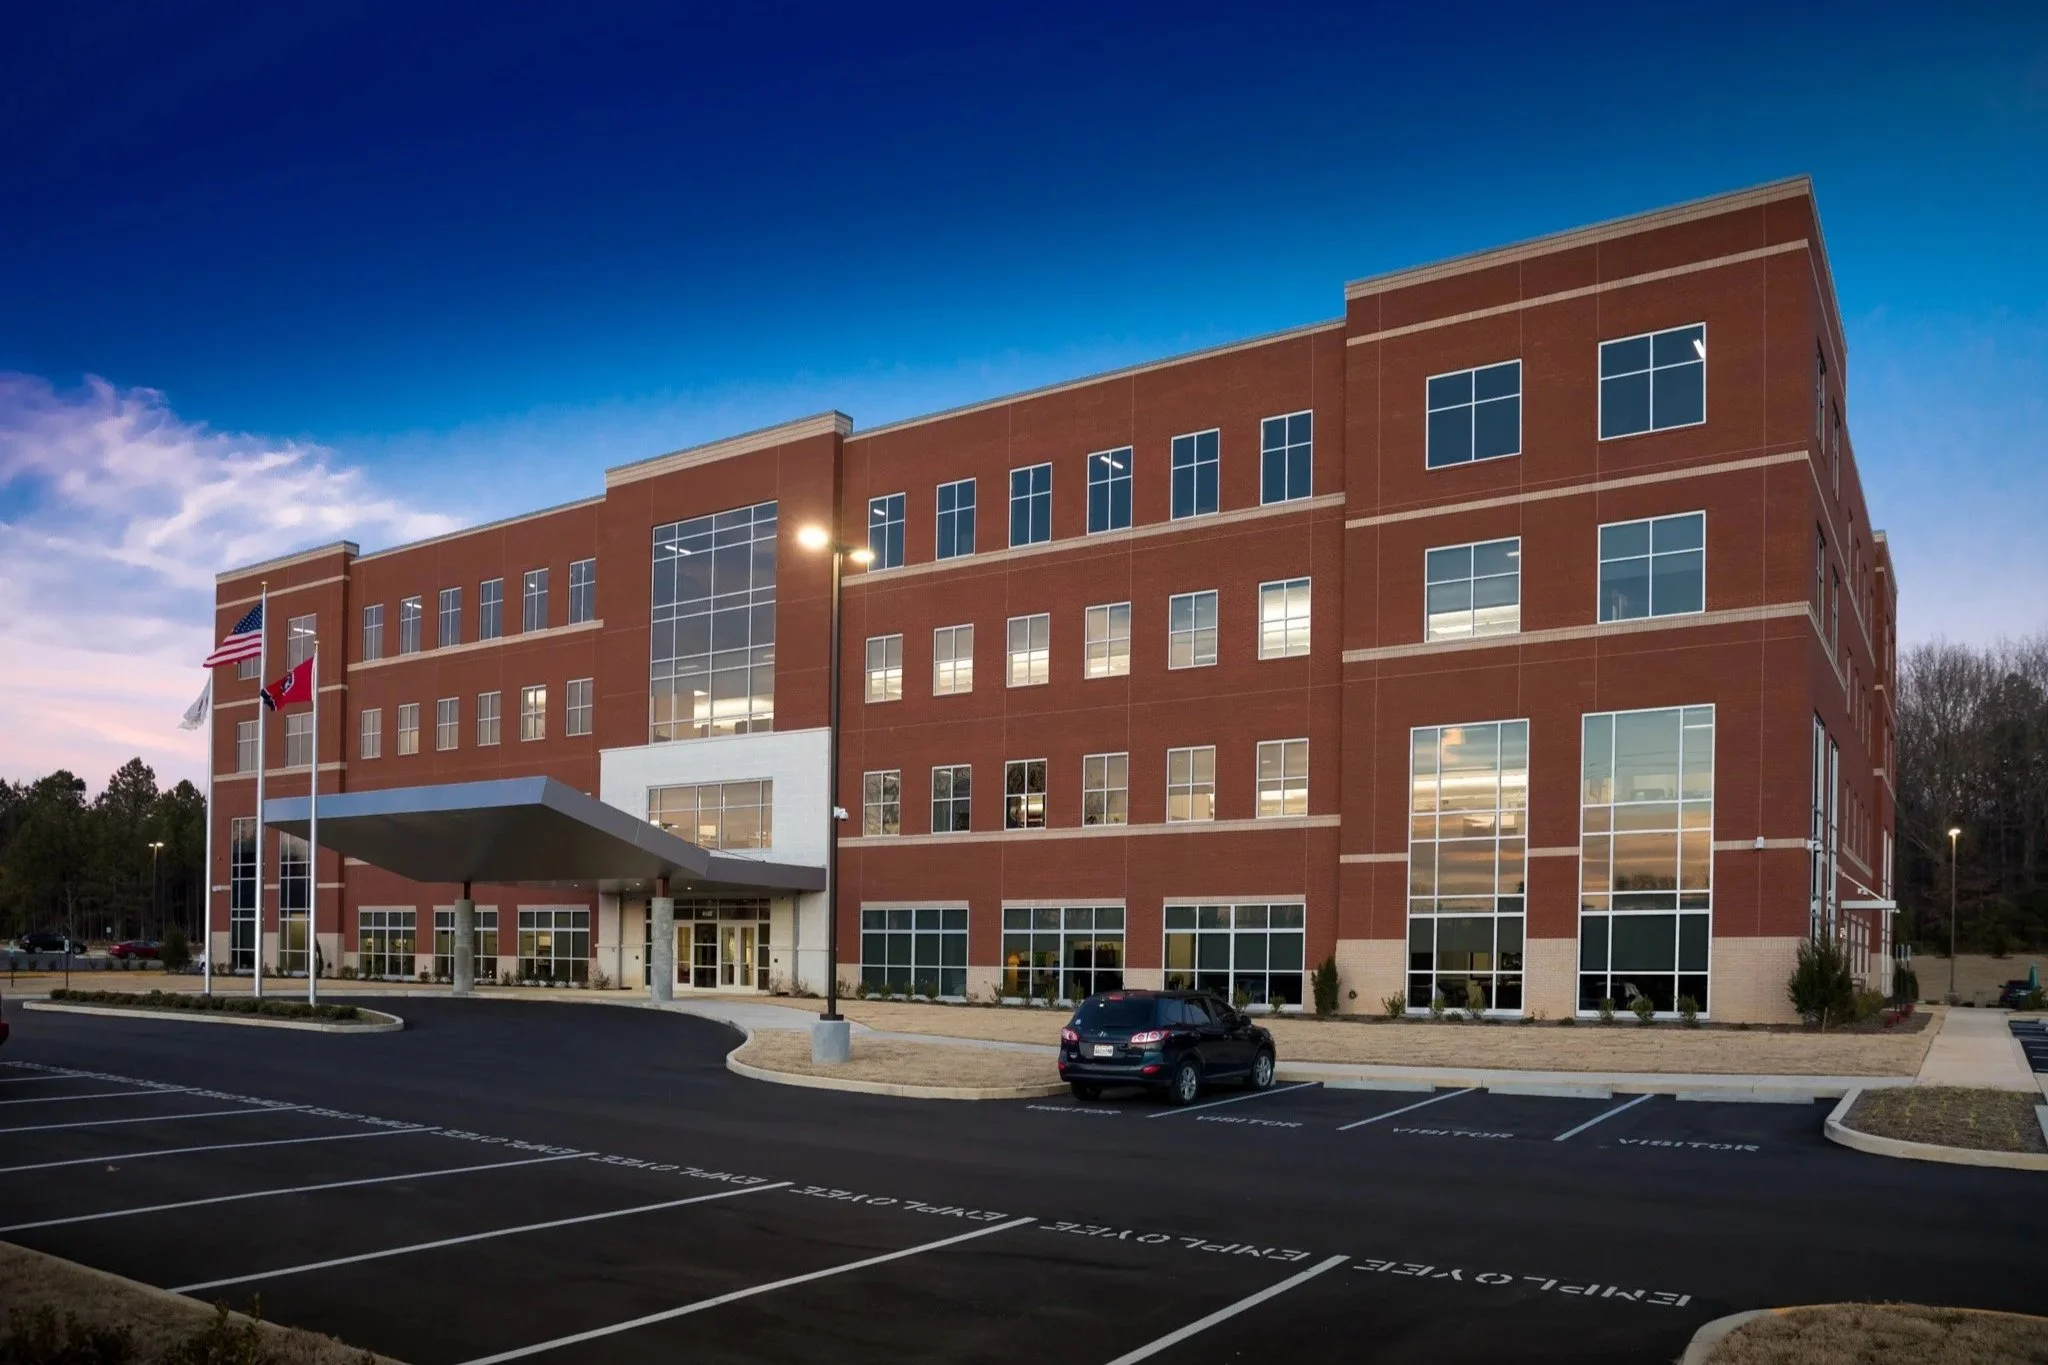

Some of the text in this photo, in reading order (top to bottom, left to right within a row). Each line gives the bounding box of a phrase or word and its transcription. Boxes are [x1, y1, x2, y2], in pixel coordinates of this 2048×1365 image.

[1196, 1115, 1303, 1128] VISITOR
[1393, 1127, 1514, 1139] VISITOR
[1618, 1138, 1760, 1152] VISITOR
[589, 1154, 768, 1185] EMPLOYEE
[789, 1186, 1008, 1221] EMPLOYEE
[1040, 1221, 1311, 1262] EMPLOYEE
[1353, 1258, 1692, 1307] EMPLOYEE
